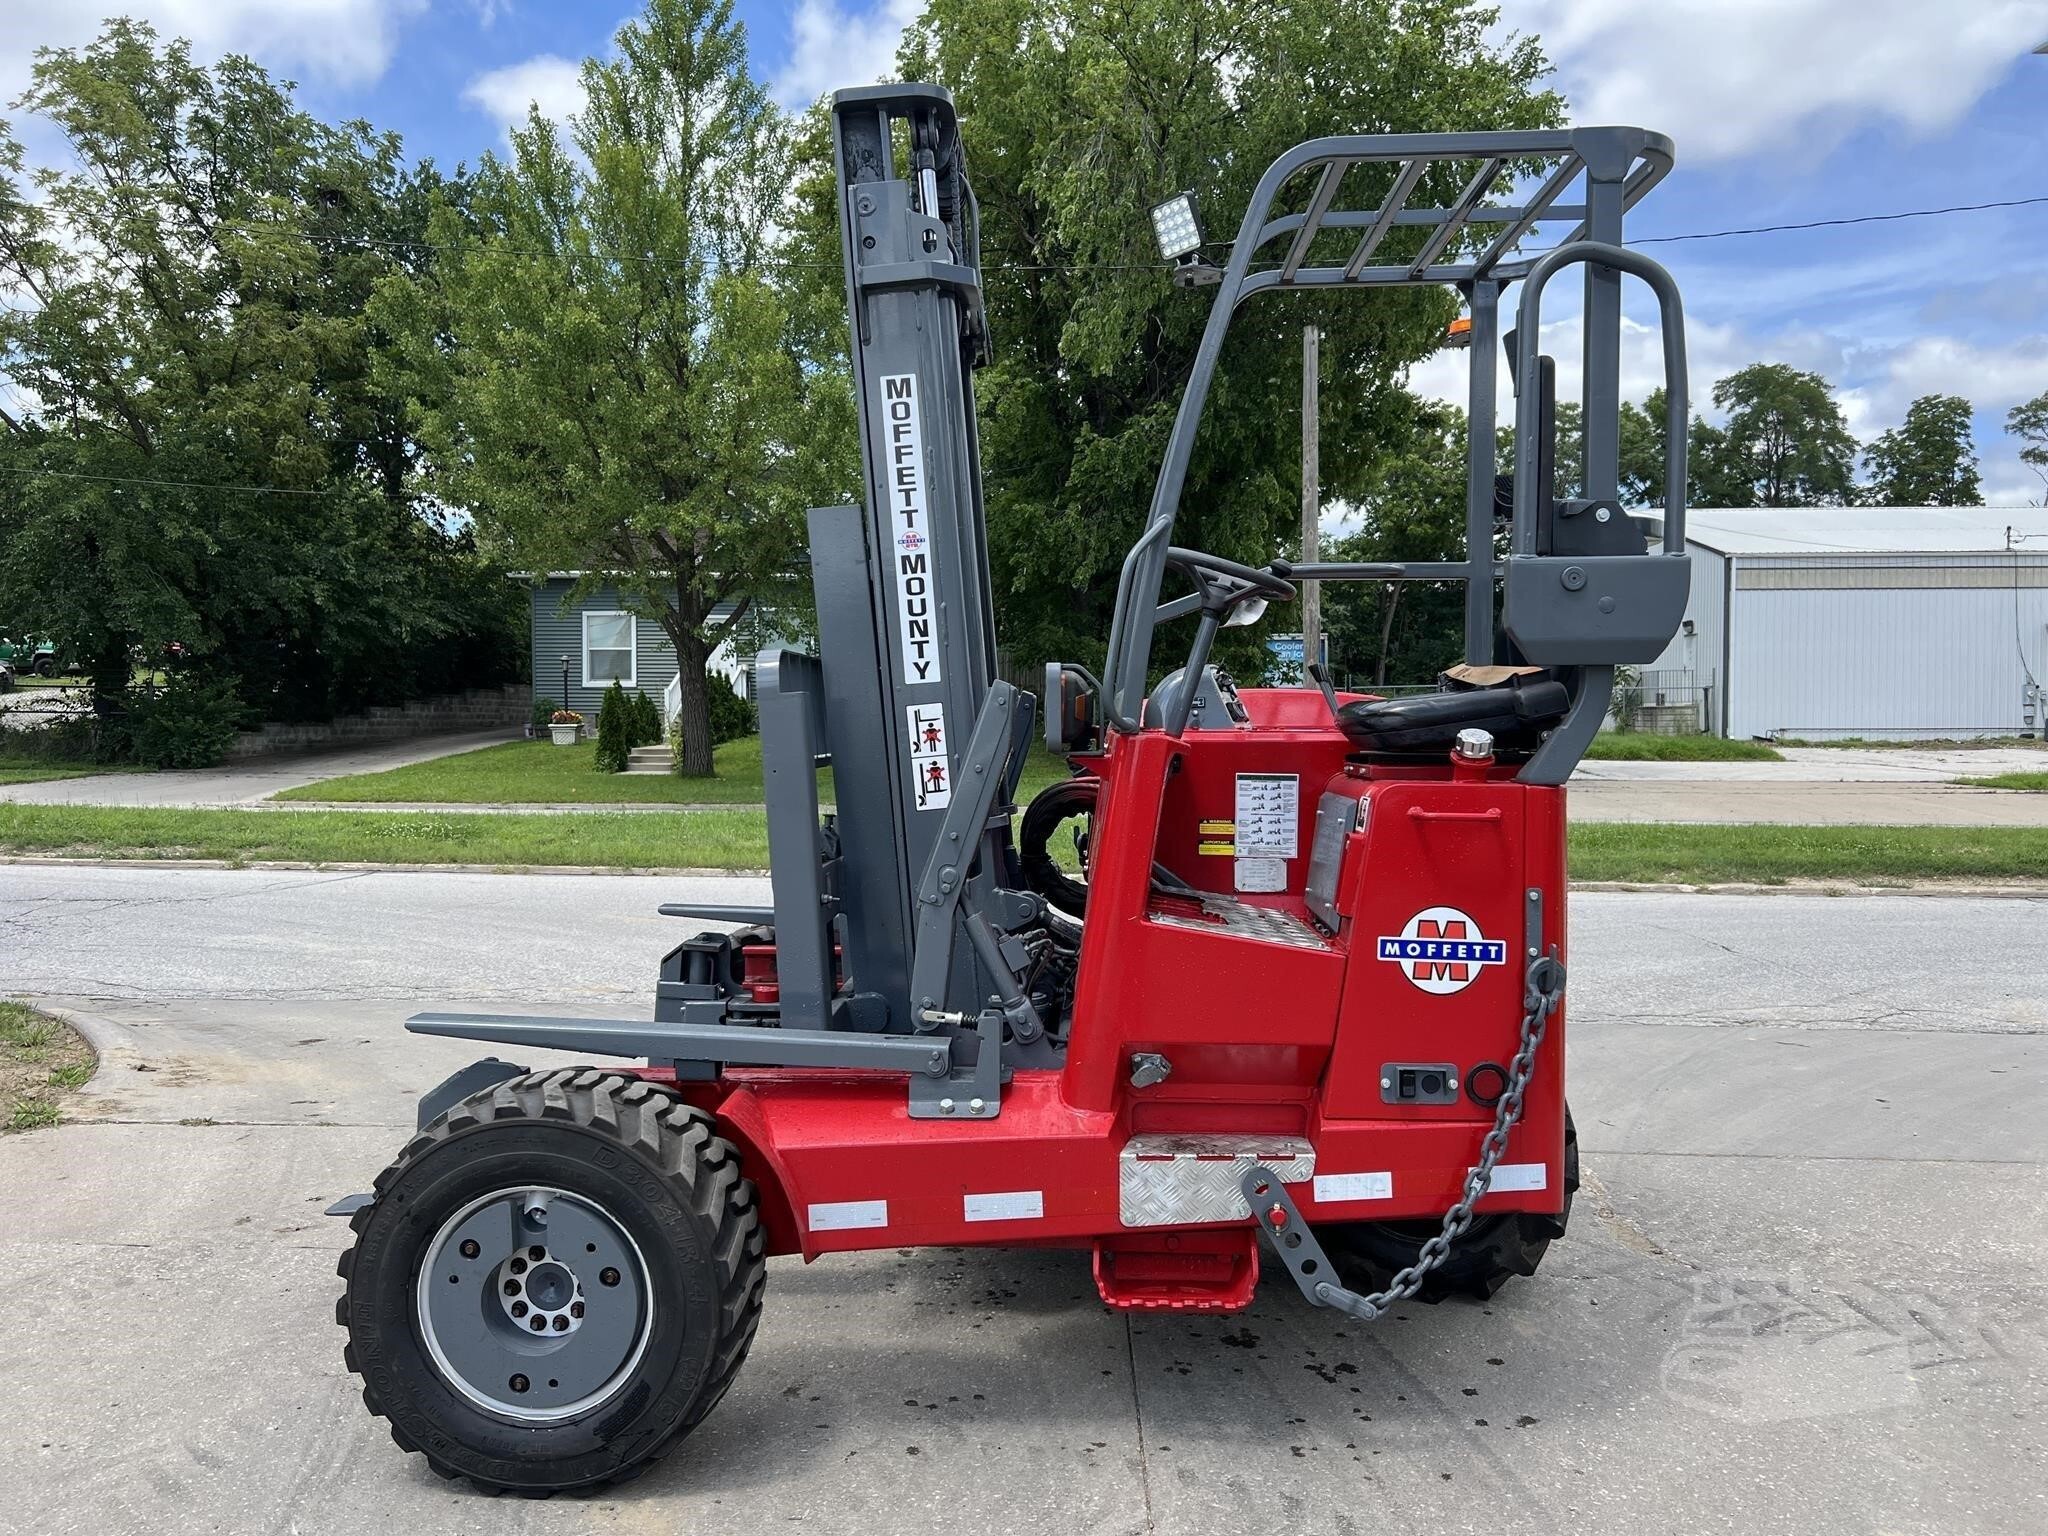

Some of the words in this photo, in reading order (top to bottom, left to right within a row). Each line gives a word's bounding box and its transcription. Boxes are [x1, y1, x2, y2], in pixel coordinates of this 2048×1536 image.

[886, 378, 919, 528] MOFFETT
[901, 554, 931, 680] MOUNTY
[1385, 942, 1499, 959] MOFFETT
